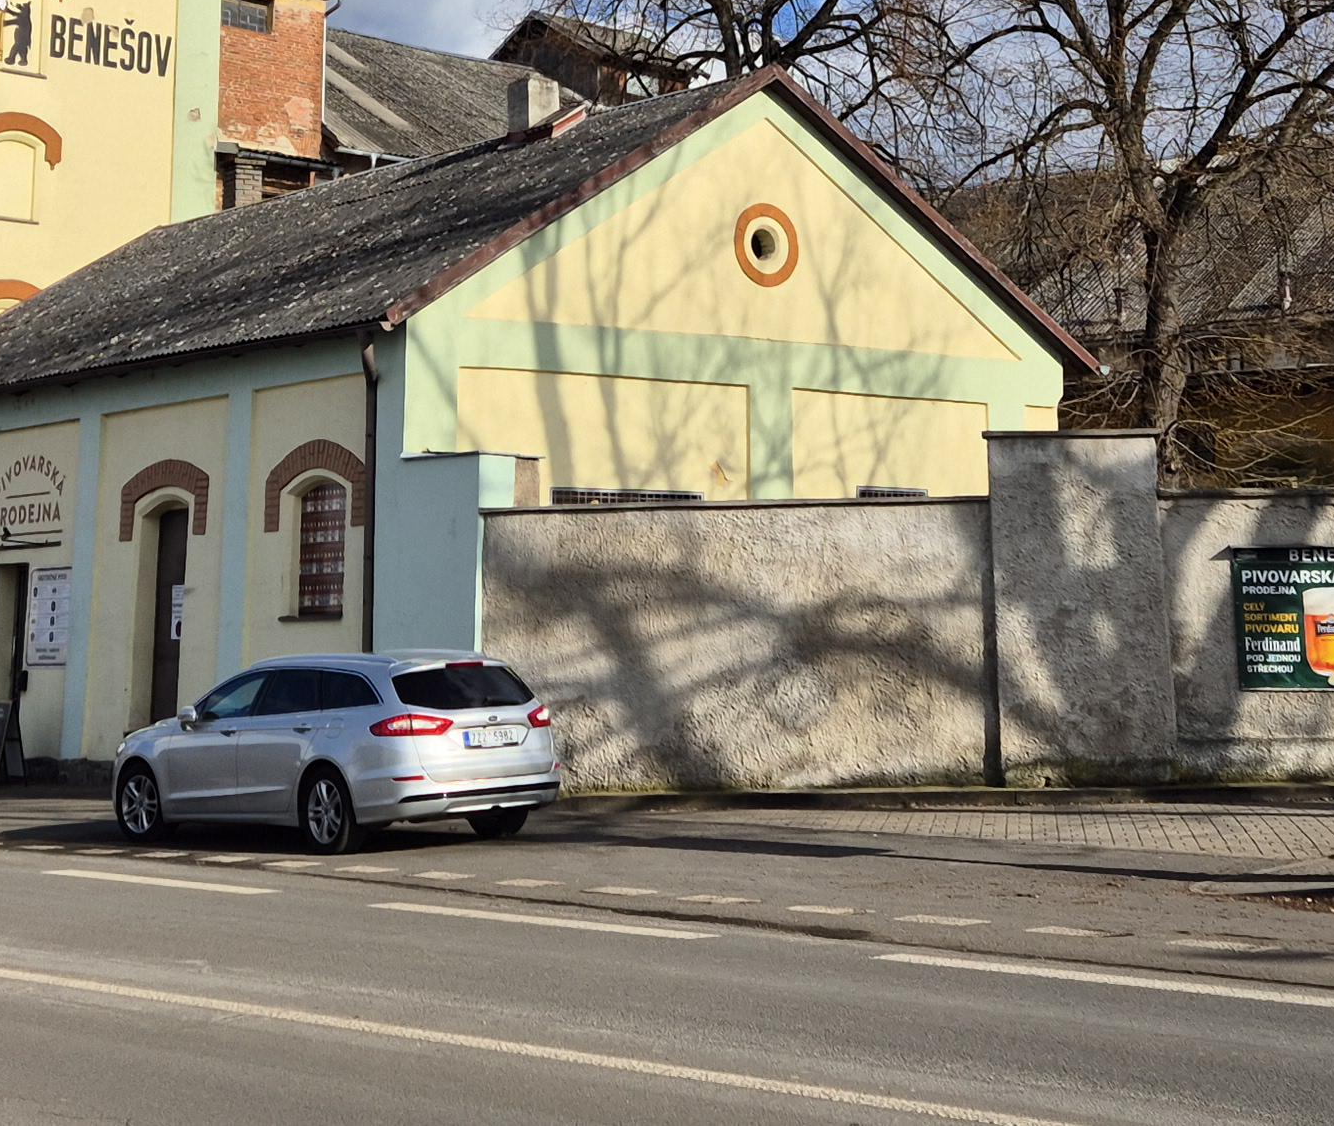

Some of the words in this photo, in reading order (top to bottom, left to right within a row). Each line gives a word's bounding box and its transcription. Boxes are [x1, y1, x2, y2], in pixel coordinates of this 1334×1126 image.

[50, 18, 172, 77] BENEŠOV
[1242, 586, 1297, 595] PRODEJNA
[1244, 613, 1298, 622] SORTIMENT
[1245, 624, 1299, 634] PIVOVARU
[1245, 637, 1301, 652] Ferdinand
[1246, 654, 1264, 662] POD
[1266, 654, 1301, 662] JEDNOU
[1247, 664, 1294, 674] STŘECHOU
